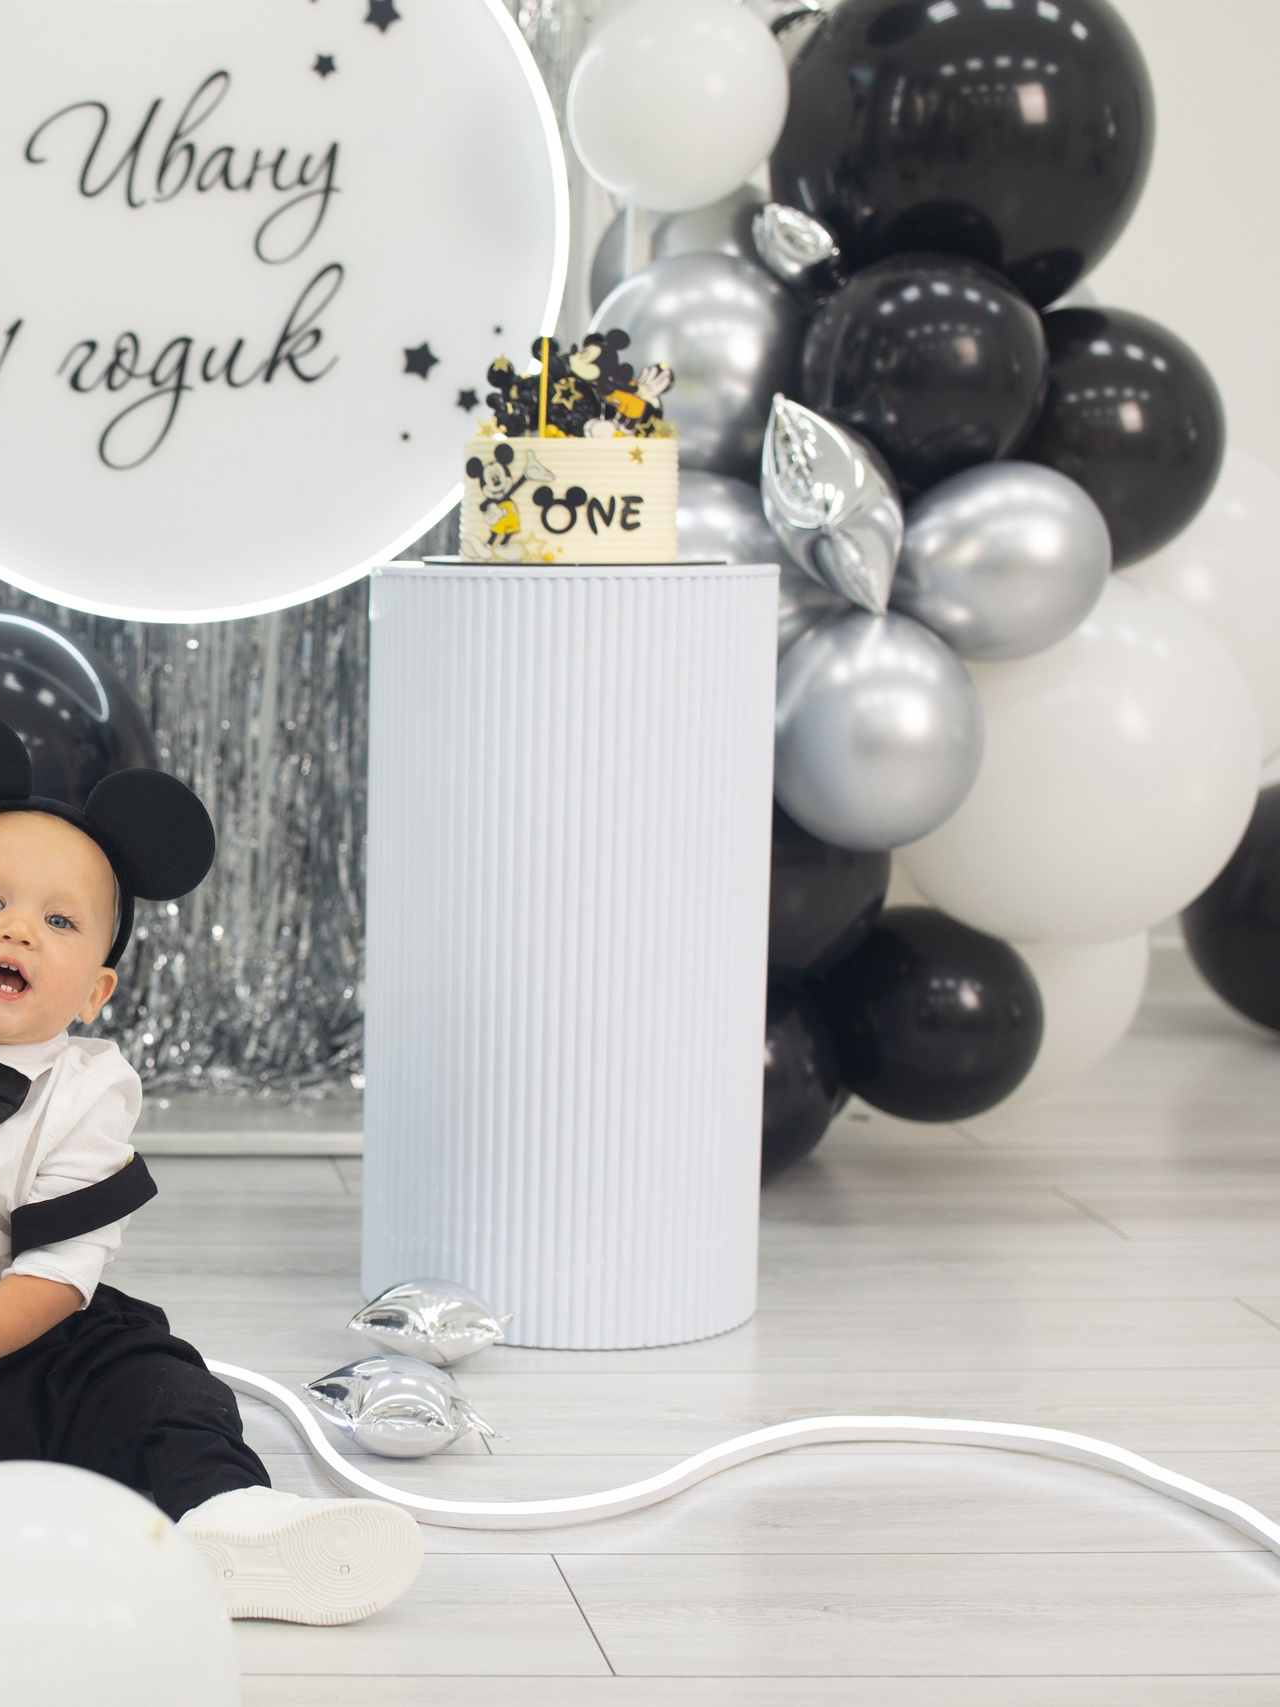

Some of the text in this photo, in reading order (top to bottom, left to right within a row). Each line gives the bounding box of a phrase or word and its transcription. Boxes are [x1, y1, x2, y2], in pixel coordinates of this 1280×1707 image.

[24, 70, 342, 265] Ивану
[56, 263, 345, 470] годик
[533, 485, 644, 535] ONE
